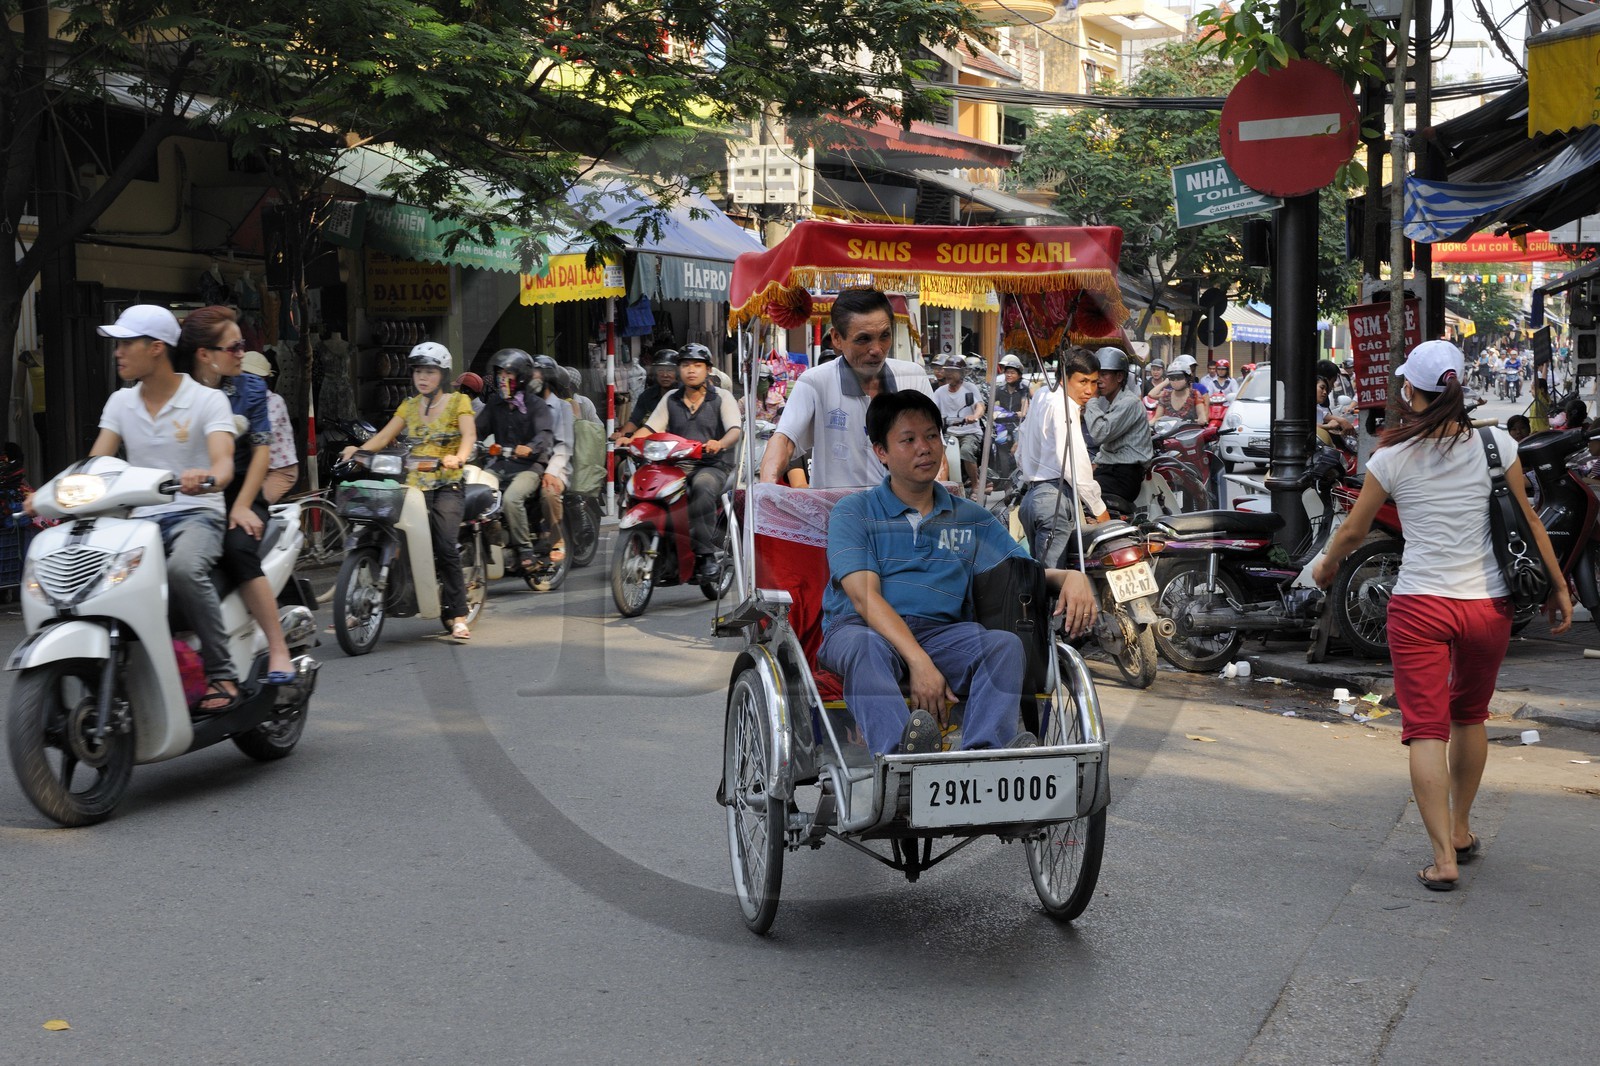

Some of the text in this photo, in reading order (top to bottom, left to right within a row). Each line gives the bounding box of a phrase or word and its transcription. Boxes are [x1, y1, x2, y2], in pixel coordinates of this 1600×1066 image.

[1186, 164, 1229, 192] NHÀ
[1193, 184, 1252, 202] TOILE
[847, 238, 1076, 264] SANS SOUCI SARL
[1489, 242, 1509, 252] CON
[373, 278, 446, 304] ĐẠI LỘC
[1353, 305, 1416, 337] SIM TẺ
[1358, 340, 1383, 351] CÁC
[1124, 570, 1136, 582] 31
[929, 774, 1057, 807] 29XL-0006
